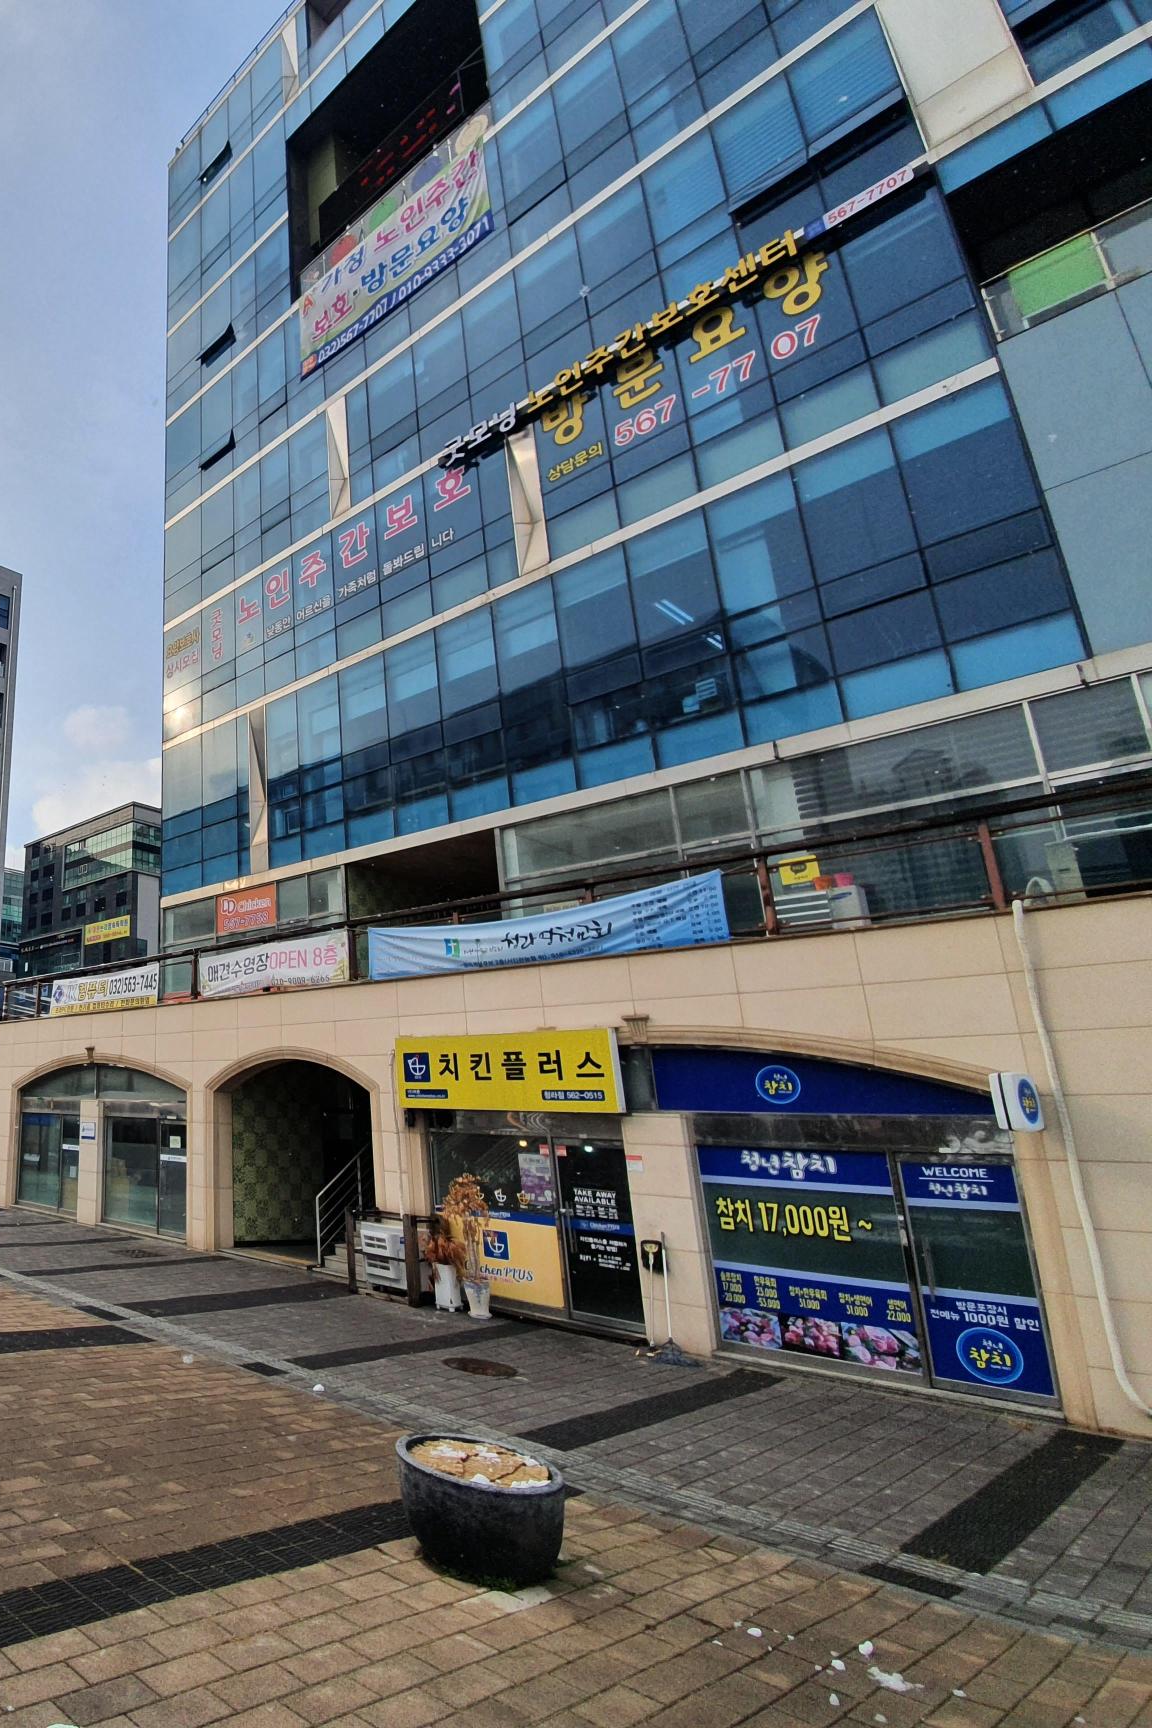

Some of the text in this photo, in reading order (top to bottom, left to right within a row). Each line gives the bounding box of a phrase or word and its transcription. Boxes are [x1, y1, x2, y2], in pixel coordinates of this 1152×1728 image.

[374, 150, 480, 252] 노인주간
[827, 169, 908, 224] 567-7707
[312, 196, 470, 340] 보호 방문요양
[318, 299, 388, 363] 032)567-7707
[398, 216, 491, 300] 010-9333-3071
[444, 229, 798, 466] 굿모닝 노인주간보호센터
[547, 442, 603, 482] 상담문의
[265, 616, 292, 639] 낮동안
[295, 594, 332, 622] 어르신을
[338, 569, 377, 599] 가족처럼
[312, 945, 338, 966] 8층
[438, 1049, 606, 1082] 치킨플러스
[566, 1090, 603, 1101] 562-0515
[764, 1080, 793, 1095] 참치
[741, 1149, 838, 1180] 청년참치
[921, 1166, 989, 1179] WELCOME
[573, 1188, 616, 1199] TAKE AWAY
[574, 1196, 617, 1206] AVAILABLE
[928, 1182, 988, 1199] 청년참치
[715, 1197, 755, 1233] 참치
[757, 1201, 852, 1242] 17,000원
[930, 1308, 1041, 1332] 전메뉴 1000원 할인
[969, 1347, 1012, 1369] 참치
